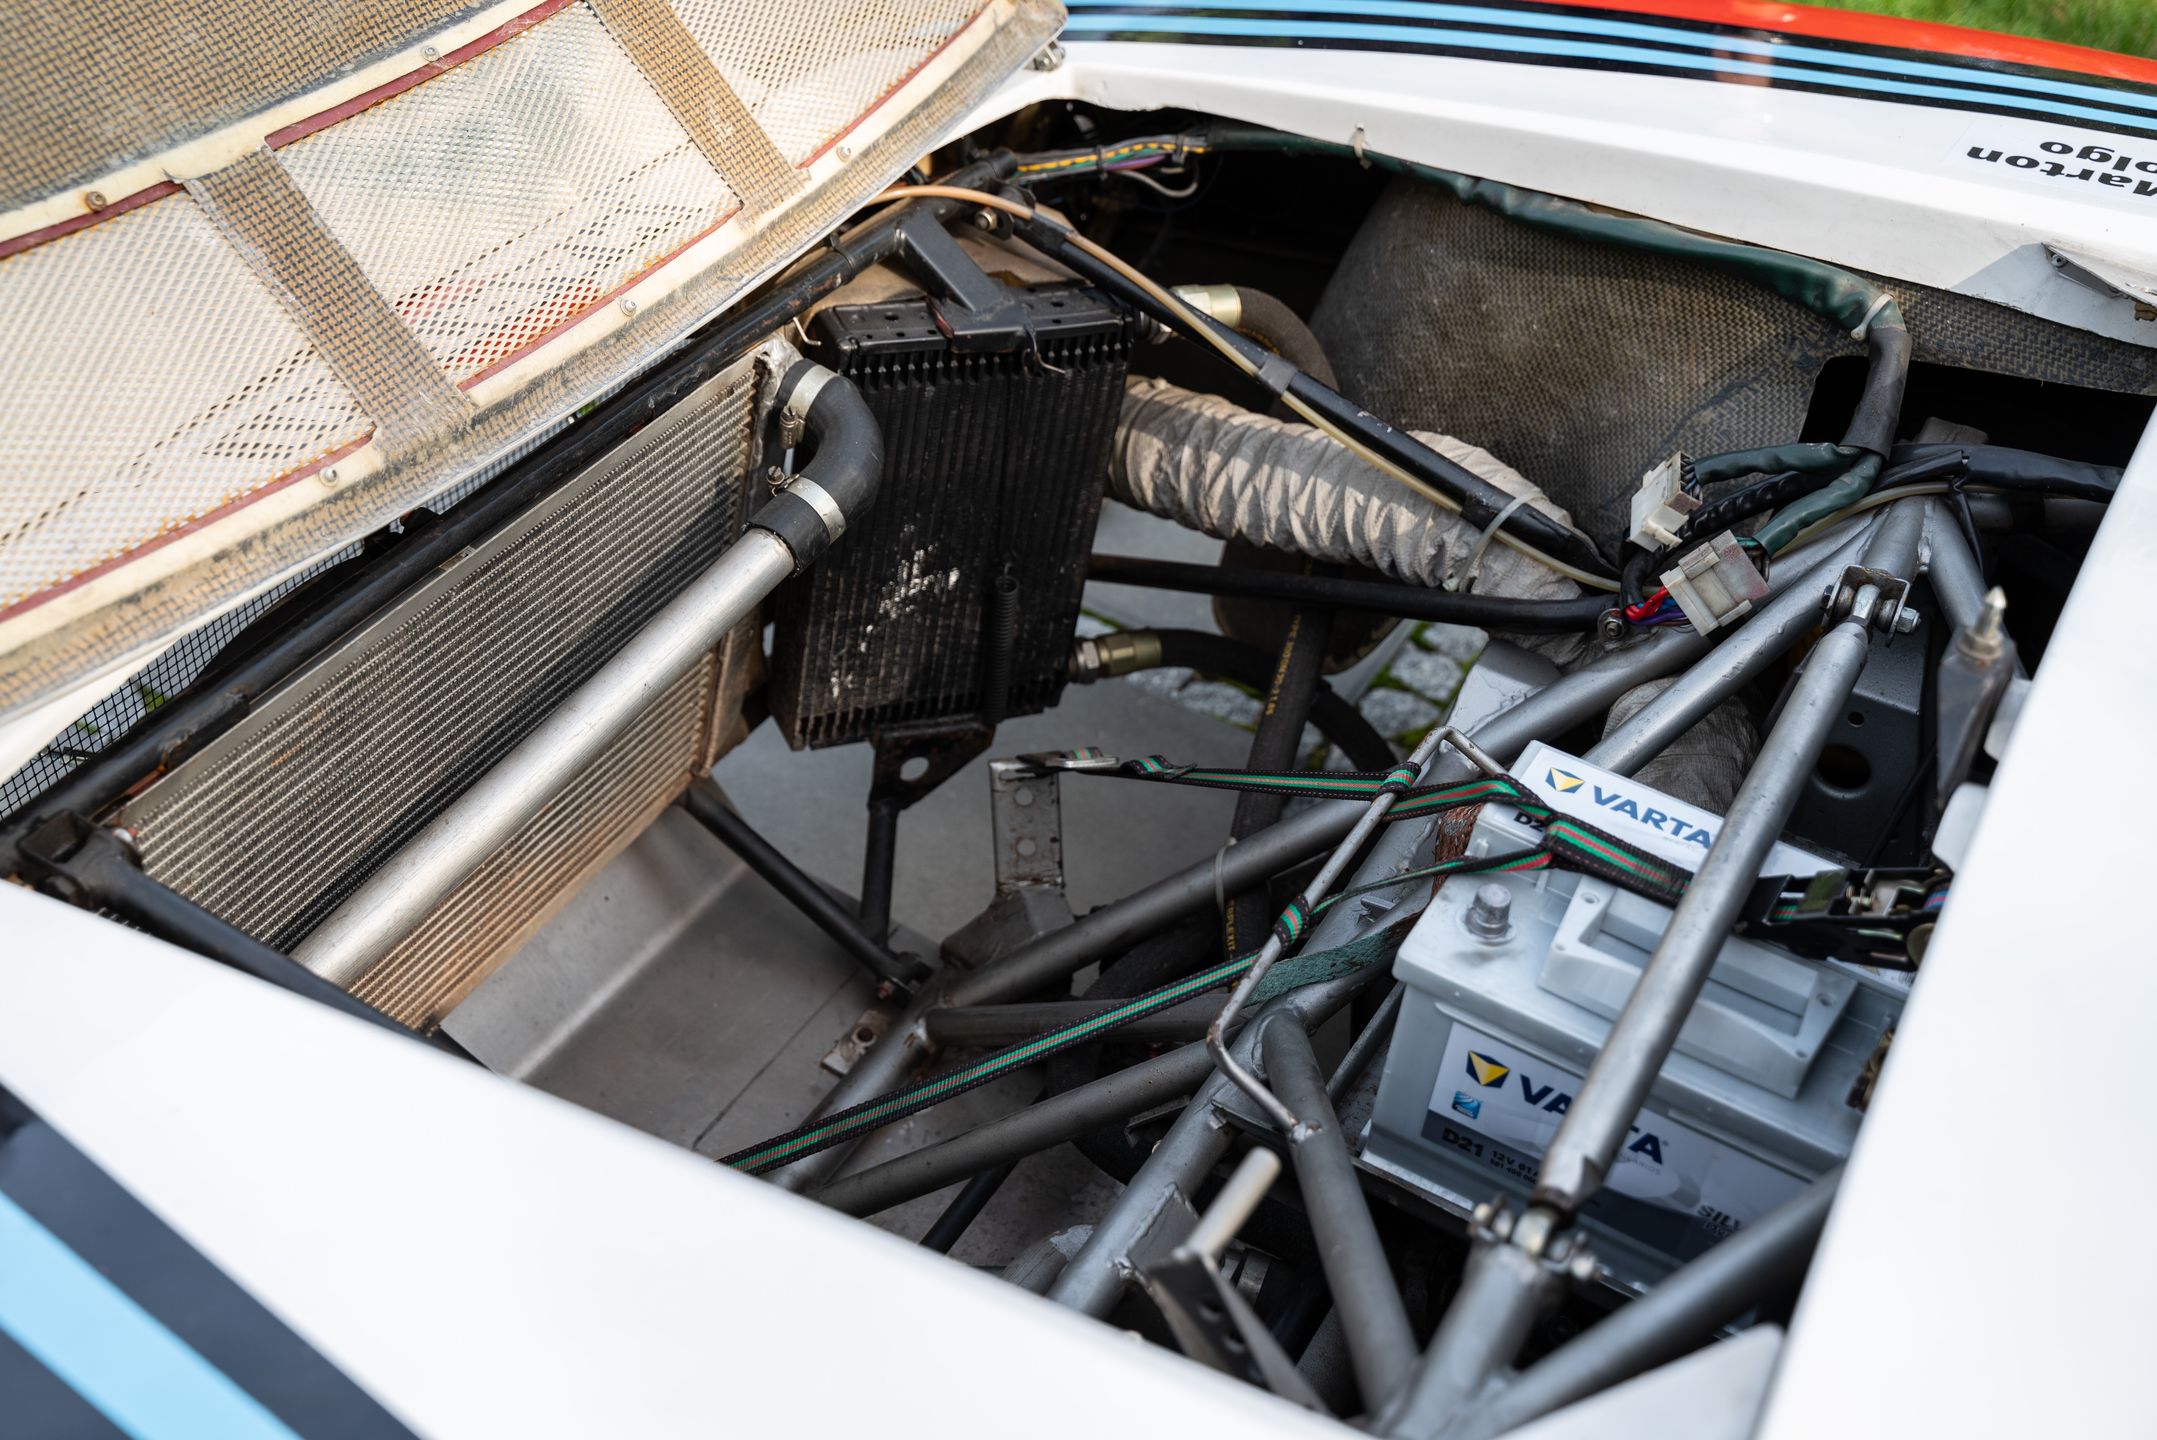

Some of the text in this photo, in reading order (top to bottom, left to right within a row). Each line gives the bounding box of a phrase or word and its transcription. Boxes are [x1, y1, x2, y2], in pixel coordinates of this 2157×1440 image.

[1514, 811, 1546, 833] D2
[1593, 785, 1712, 849] VARTA
[1520, 1073, 1663, 1166] VAA
[1441, 1127, 1484, 1158] D21
[1492, 1150, 1515, 1165] 12V
